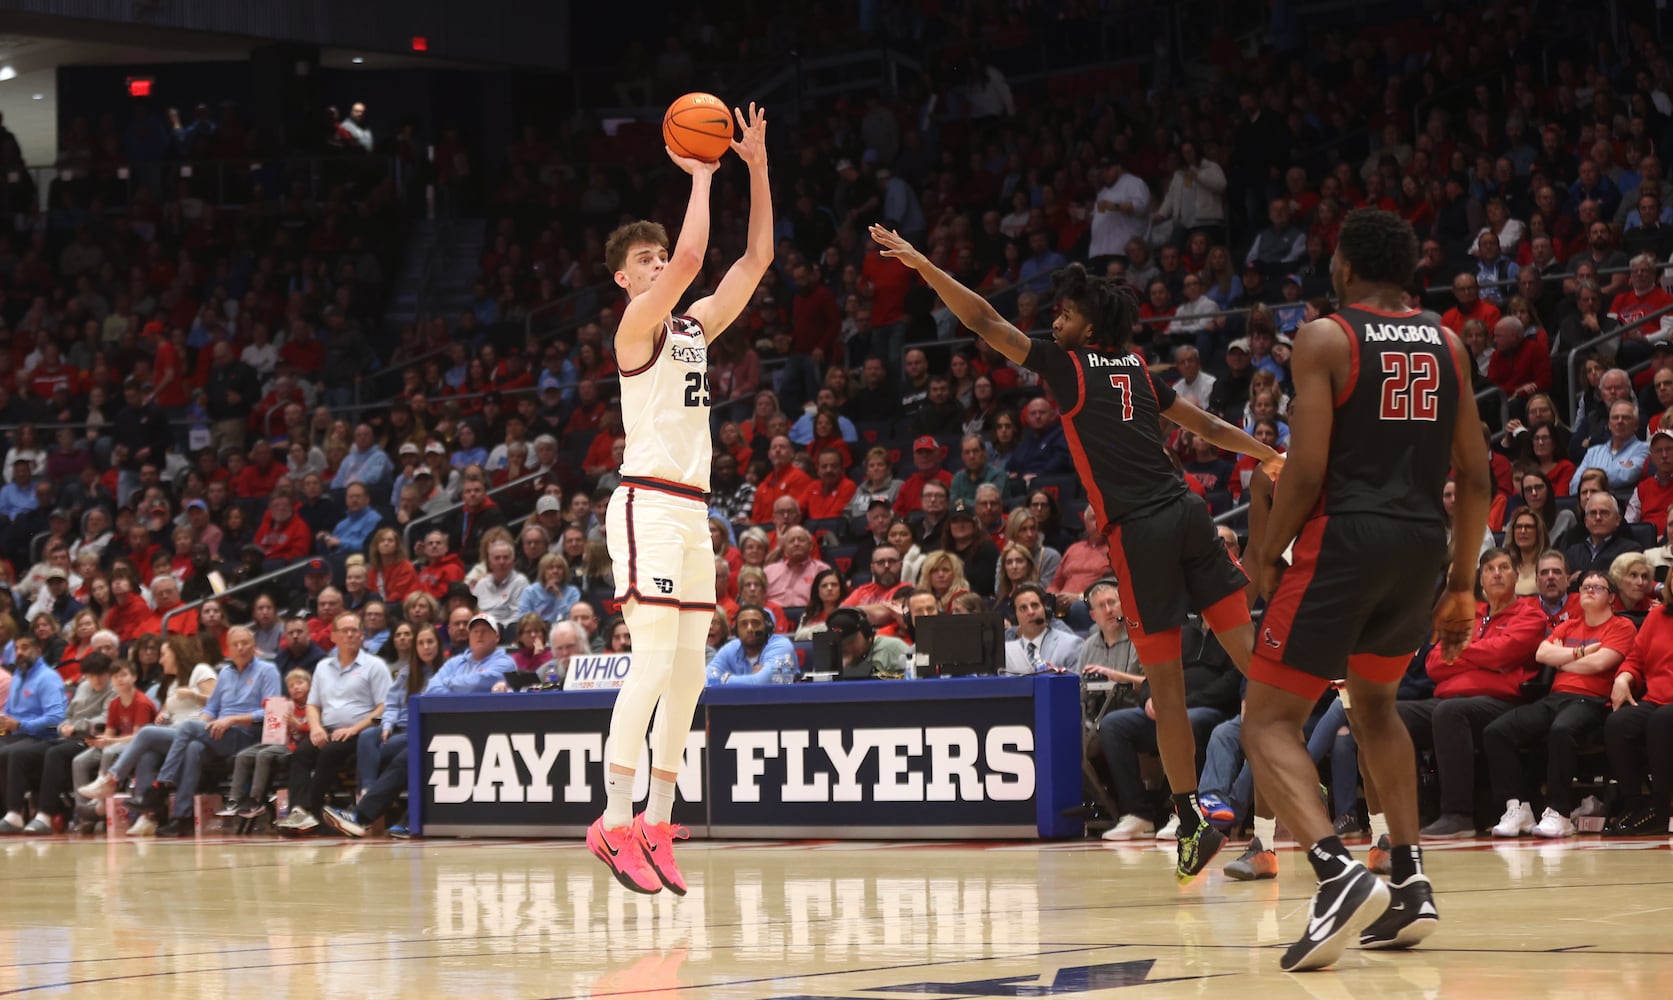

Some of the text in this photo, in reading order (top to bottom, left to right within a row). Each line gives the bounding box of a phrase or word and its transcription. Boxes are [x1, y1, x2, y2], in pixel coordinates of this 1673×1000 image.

[1365, 323, 1442, 345] AJOGBOR
[1109, 374, 1134, 421] 7
[1379, 352, 1440, 421] 22
[575, 656, 631, 680] WHIO
[724, 725, 1035, 802] FLYERS
